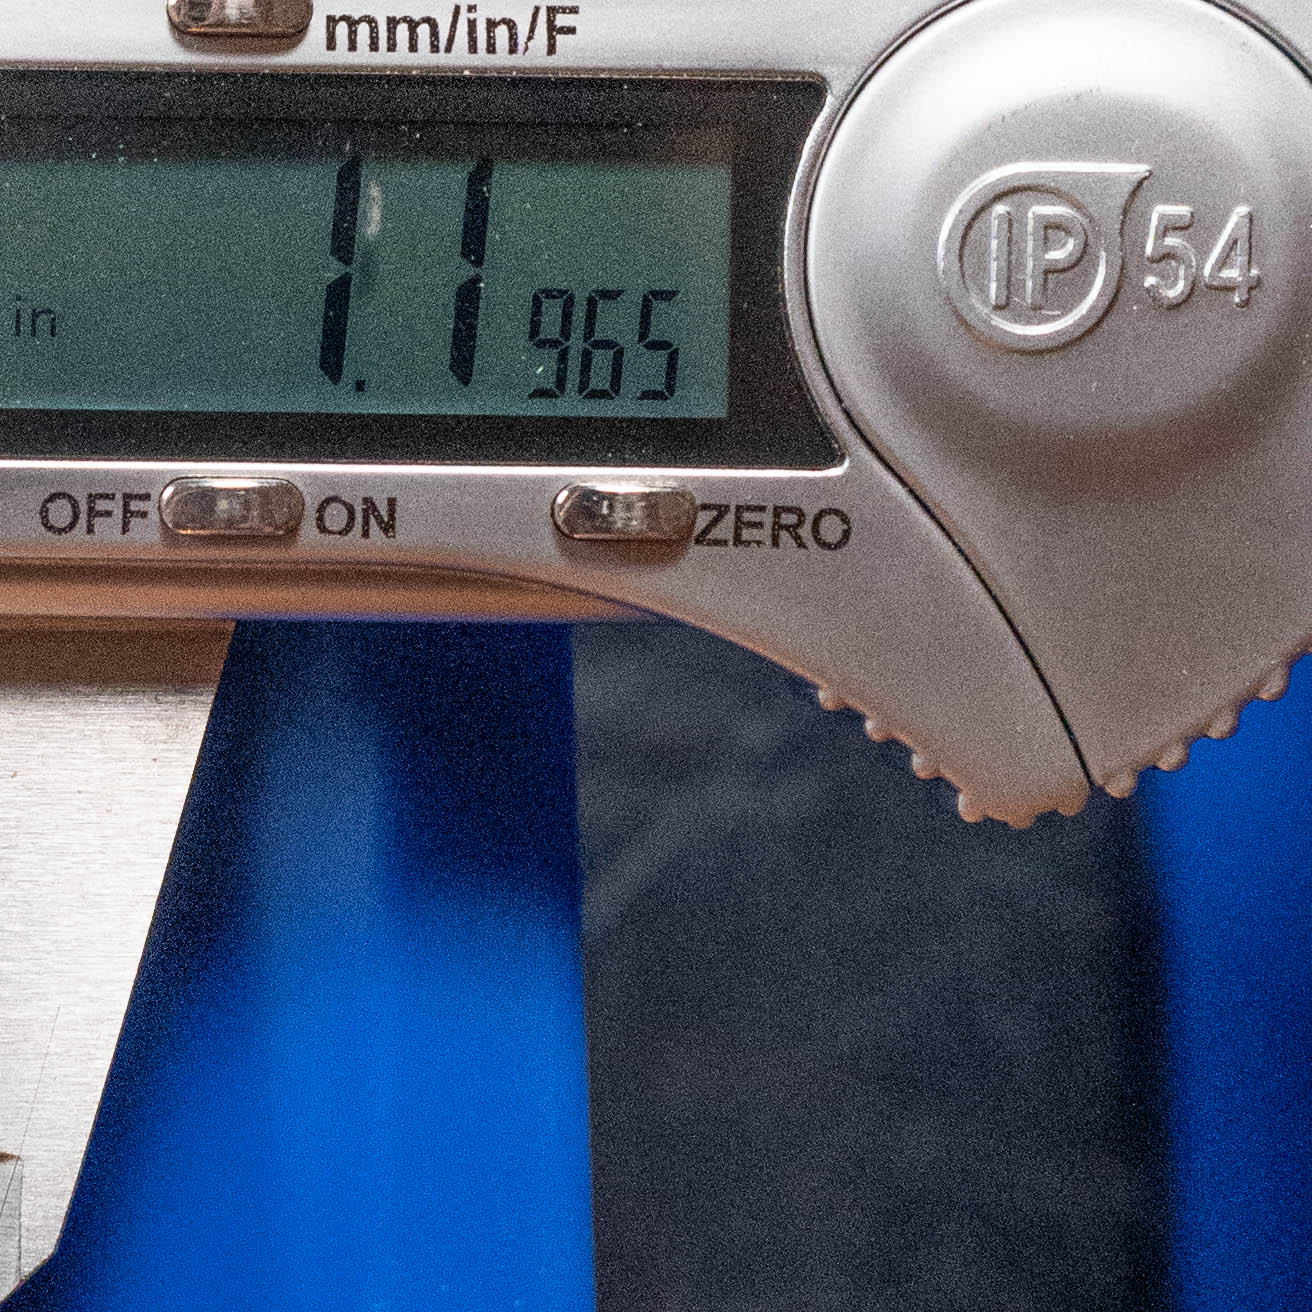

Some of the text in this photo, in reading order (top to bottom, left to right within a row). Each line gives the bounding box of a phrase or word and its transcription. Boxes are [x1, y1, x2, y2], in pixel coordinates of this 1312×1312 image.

[326, 5, 578, 56] mm/in/F
[989, 204, 1261, 311] IP 54
[12, 295, 58, 340] in
[39, 492, 398, 540] OFF ON
[693, 501, 852, 553] ZERO
